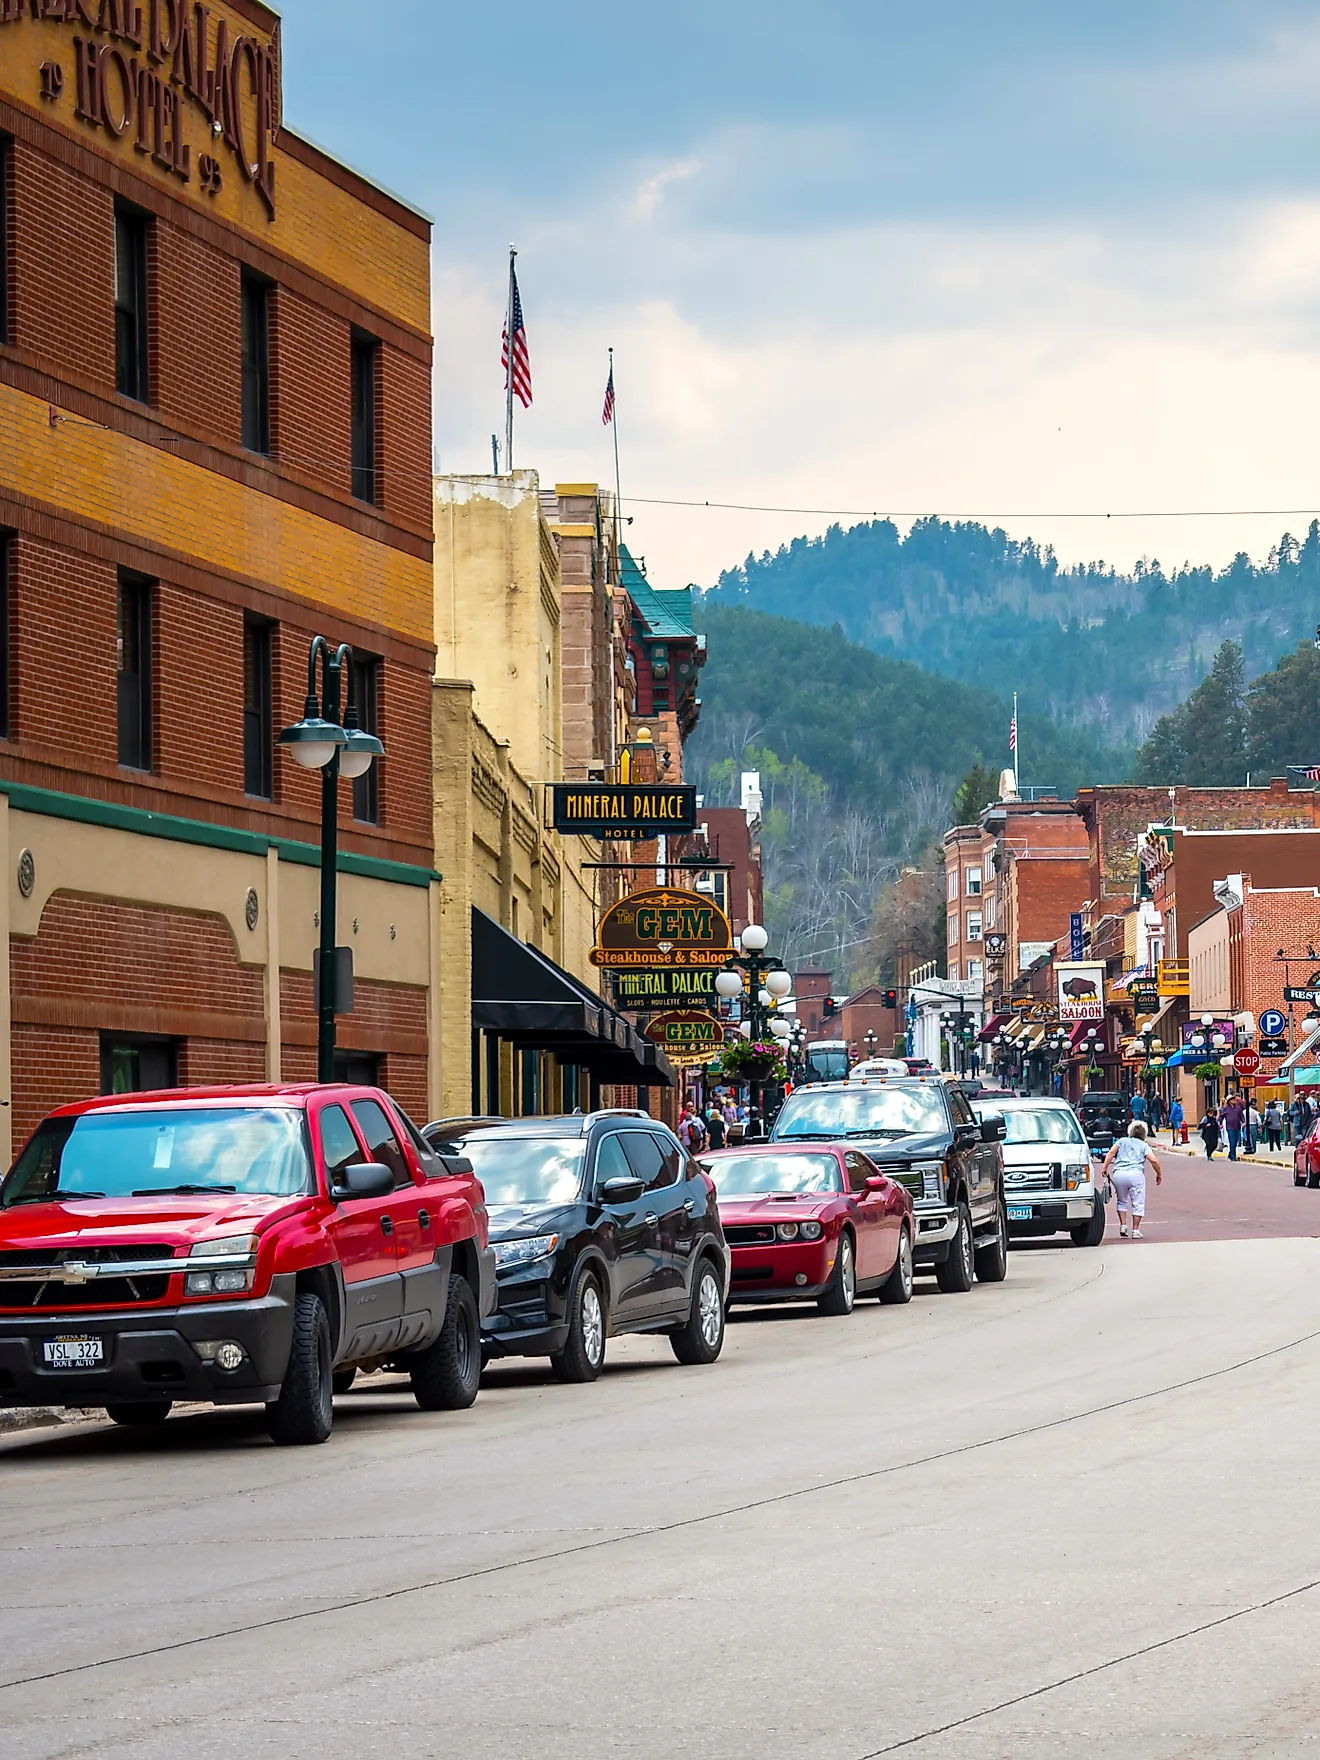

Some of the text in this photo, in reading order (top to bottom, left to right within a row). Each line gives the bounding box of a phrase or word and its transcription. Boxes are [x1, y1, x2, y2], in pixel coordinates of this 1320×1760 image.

[73, 36, 190, 183] HOTEL
[567, 795, 684, 819] MINERAL PALACE
[604, 828, 645, 839] HOTEL
[616, 907, 713, 941] The GEM
[595, 950, 735, 965] Steakhouse & Saloon
[672, 972, 714, 994] PALACE
[651, 998, 680, 1006] ROULETTE
[687, 997, 707, 1005] CARDS
[1061, 1007, 1103, 1019] SALOON
[666, 1021, 715, 1041] GEM
[1266, 1014, 1281, 1033] P
[657, 1043, 686, 1051] khouse
[1235, 1056, 1259, 1067] STOP
[48, 1342, 99, 1360] VSL 322
[53, 1359, 95, 1368] DOVE AUTO
